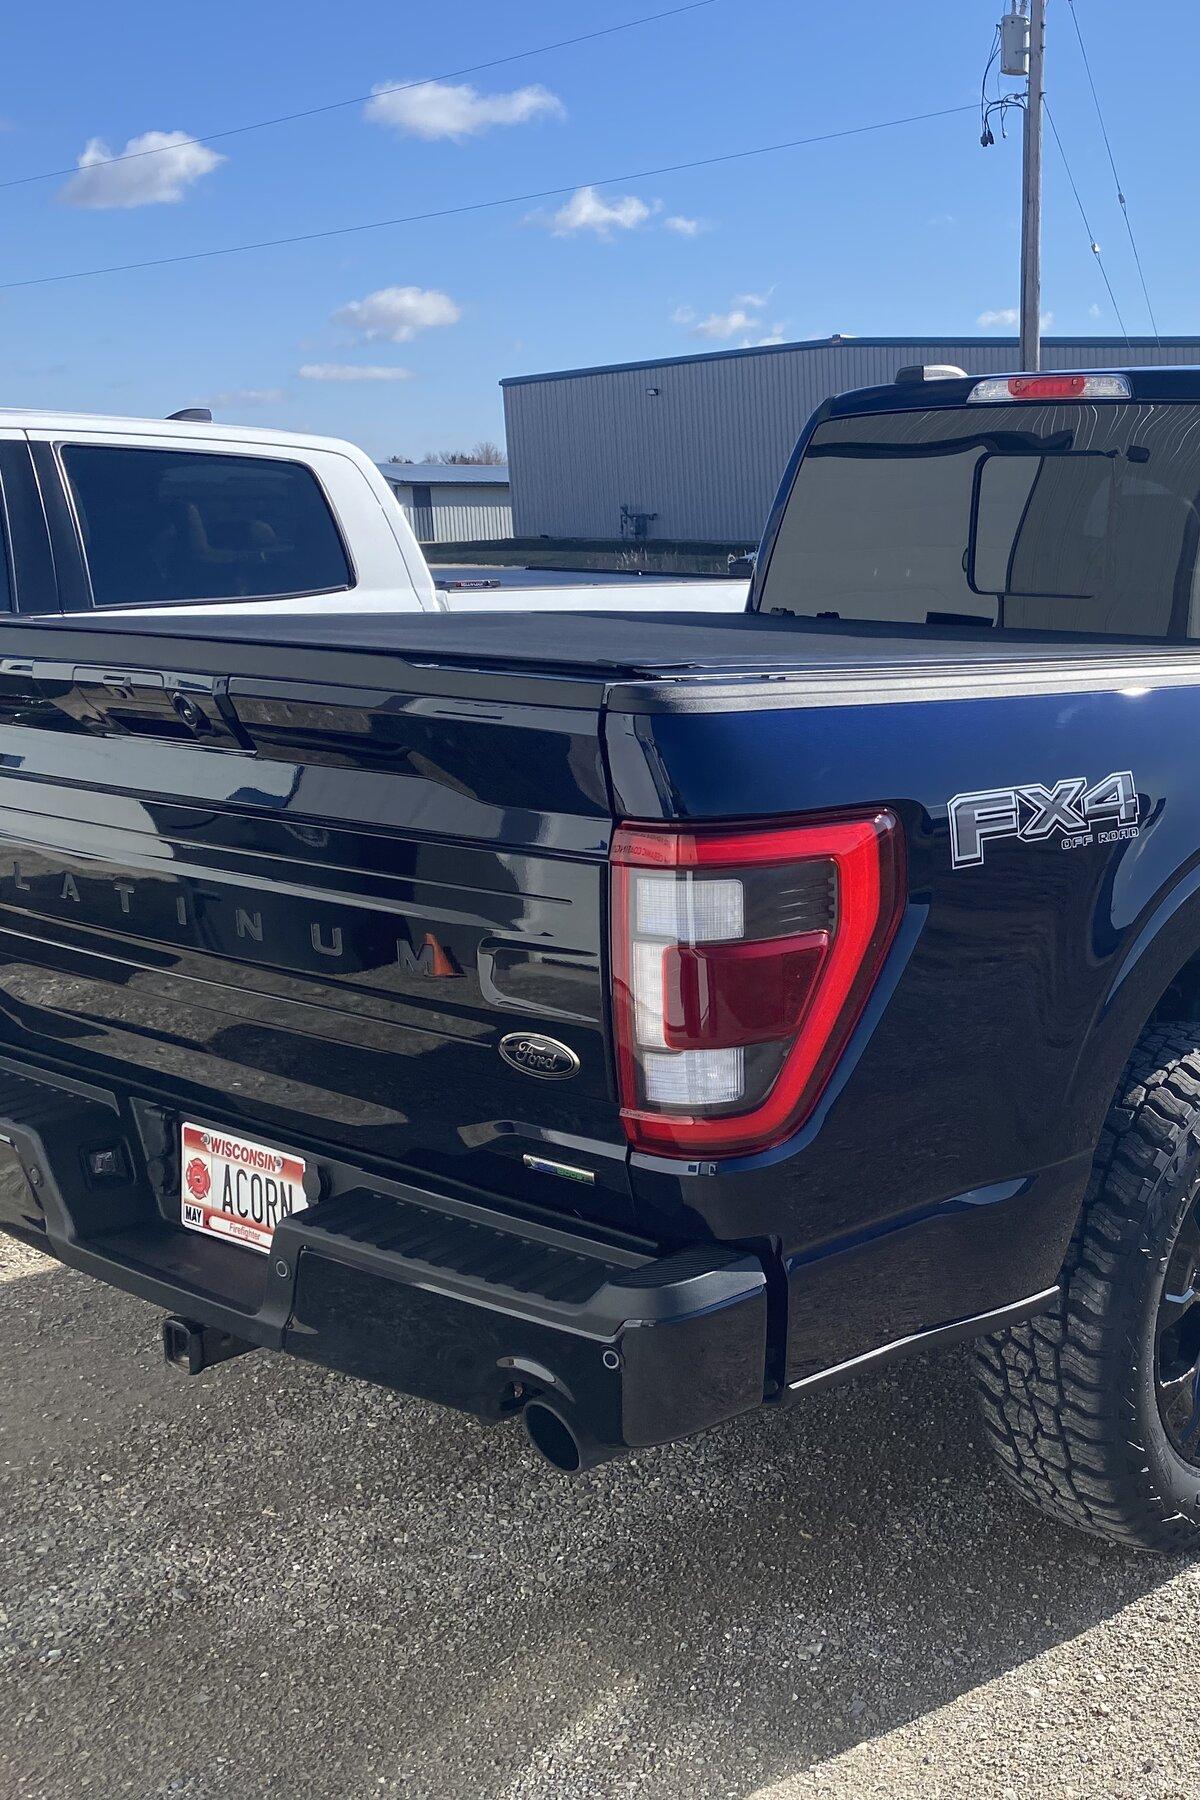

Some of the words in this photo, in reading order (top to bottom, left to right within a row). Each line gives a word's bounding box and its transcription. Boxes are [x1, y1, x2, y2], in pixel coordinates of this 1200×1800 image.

[947, 770, 1140, 870] FX4
[1061, 834, 1093, 850] OFF
[1098, 827, 1140, 843] ROAD
[515, 1041, 557, 1070] Ford
[211, 1136, 277, 1172] WISCONSIN
[222, 1164, 293, 1228] ACORN
[185, 1205, 202, 1223] MAY
[229, 1222, 261, 1241] Firefighter
